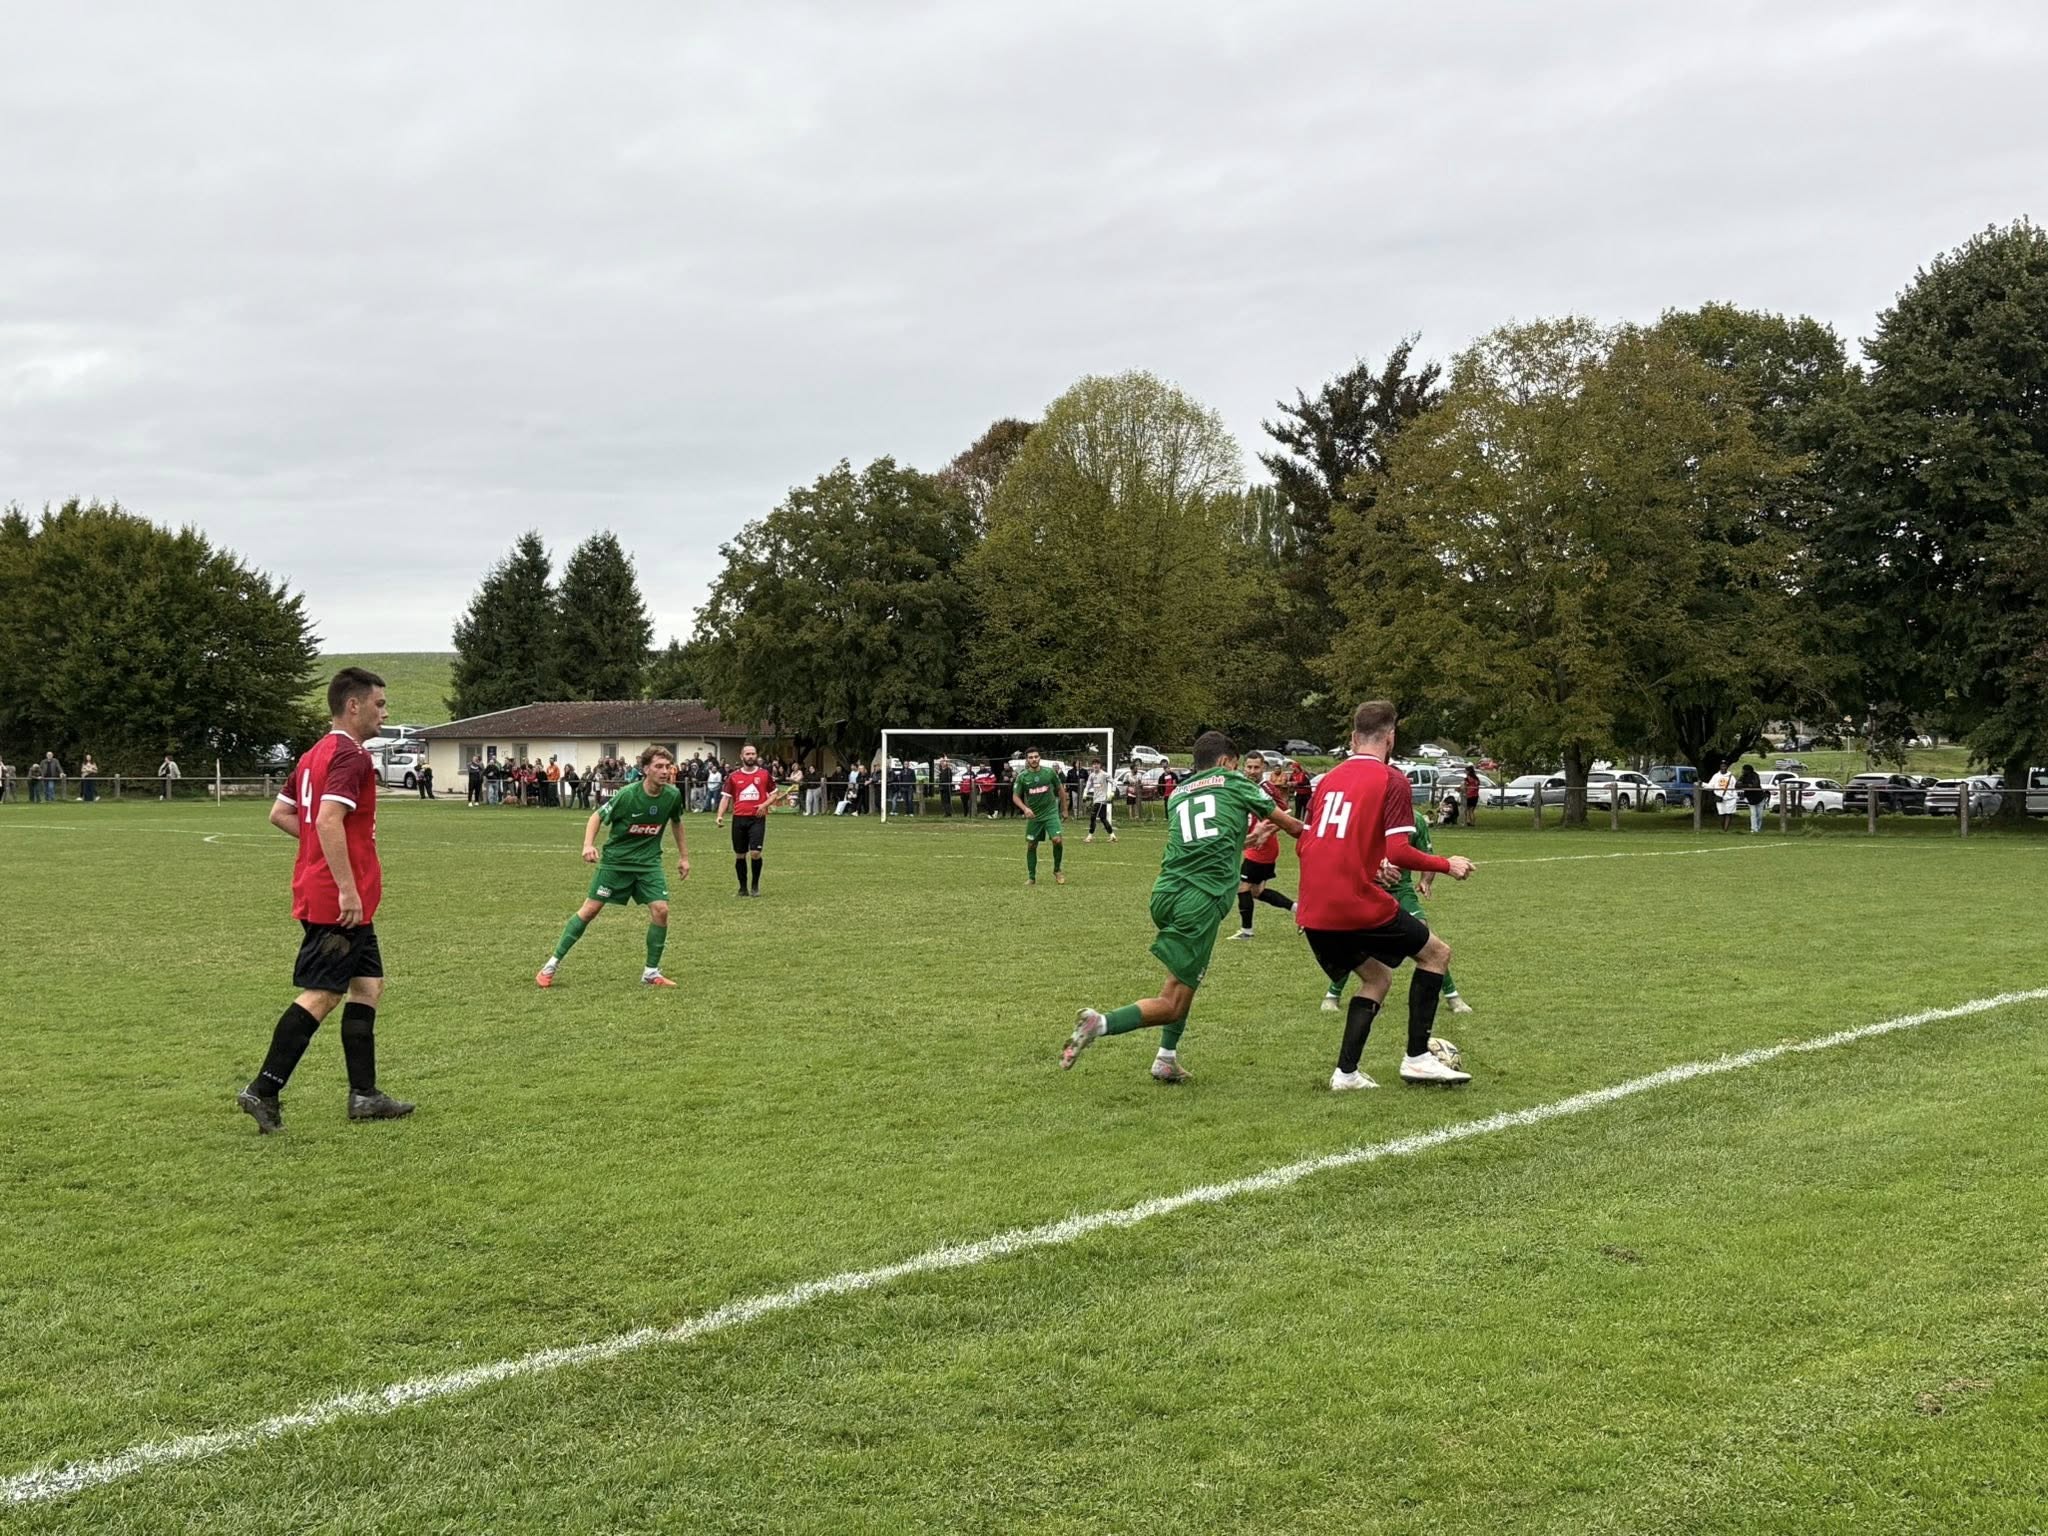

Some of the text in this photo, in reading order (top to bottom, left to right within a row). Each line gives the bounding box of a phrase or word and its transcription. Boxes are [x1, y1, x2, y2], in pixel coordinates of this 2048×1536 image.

[301, 768, 313, 823] 4
[1176, 794, 1219, 843] 12
[1316, 791, 1353, 839] 14
